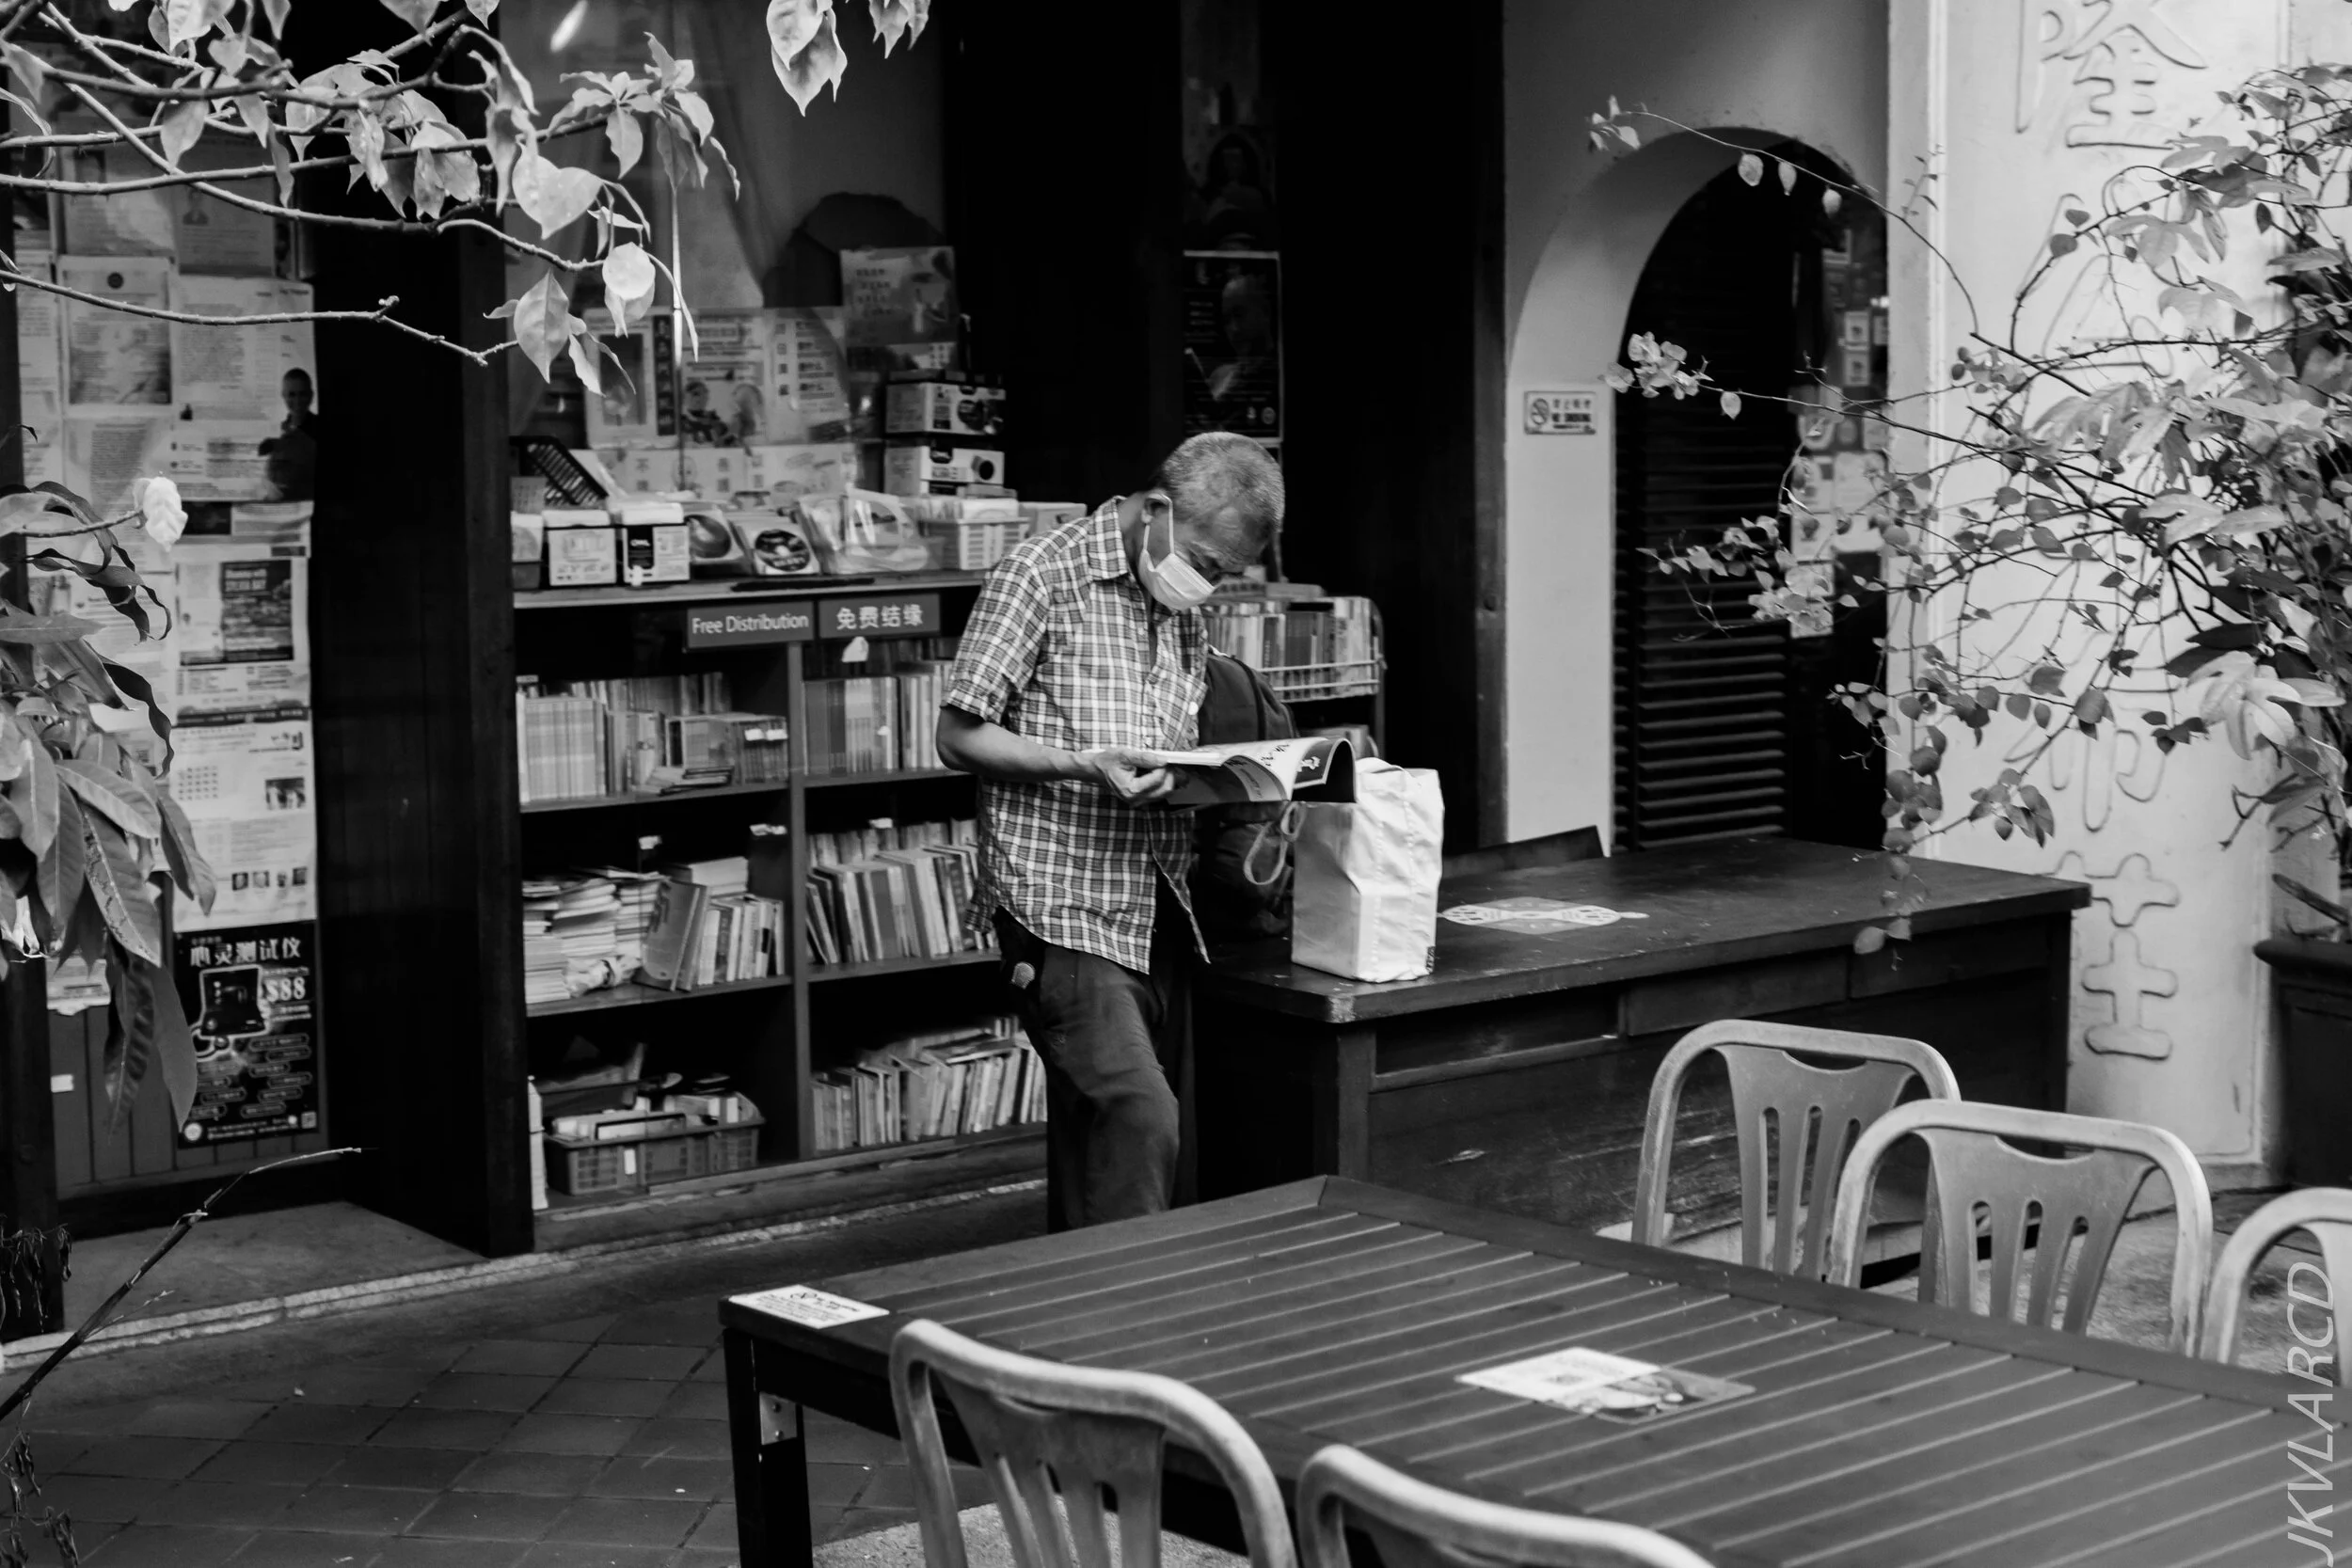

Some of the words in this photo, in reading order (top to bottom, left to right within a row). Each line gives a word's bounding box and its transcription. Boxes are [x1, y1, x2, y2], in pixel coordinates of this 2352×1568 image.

[691, 617, 723, 634] Free
[725, 612, 809, 633] Distribution
[836, 603, 924, 631] 免费结缘
